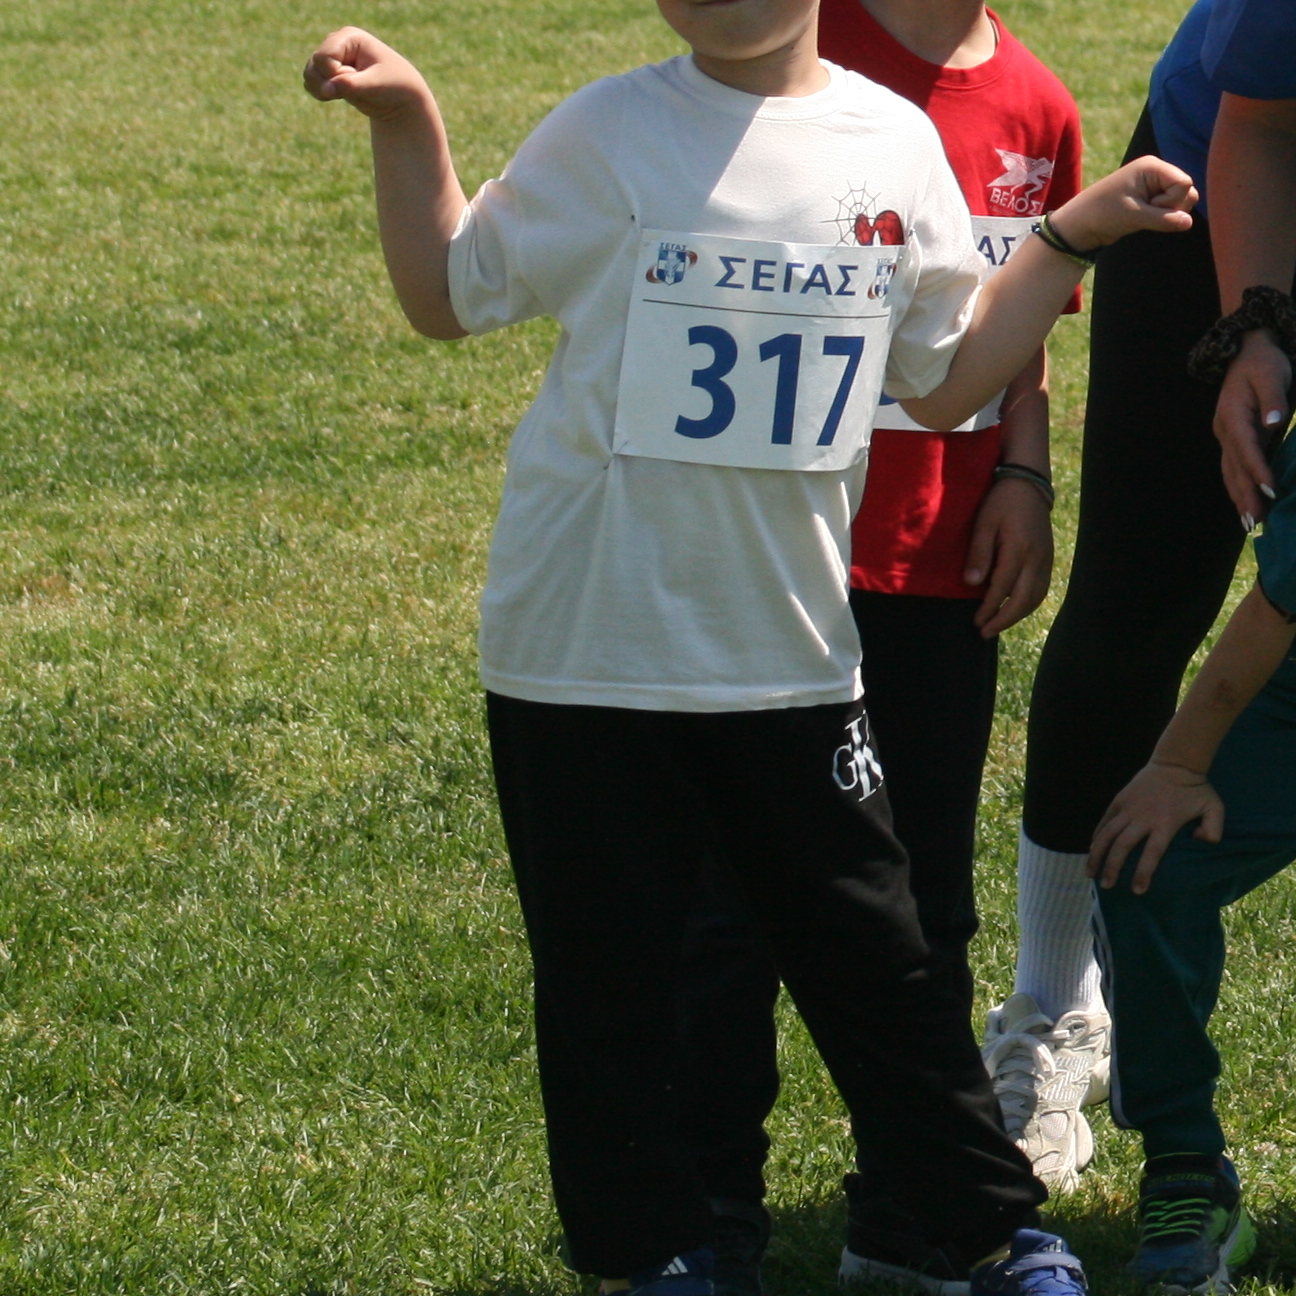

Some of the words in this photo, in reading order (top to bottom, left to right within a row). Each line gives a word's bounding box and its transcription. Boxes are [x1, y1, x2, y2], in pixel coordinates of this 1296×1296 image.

[989, 187, 1041, 216] ΒΕΛΟΣ
[714, 254, 859, 297] ΣΕΓΑΣ
[674, 323, 866, 447] 317
